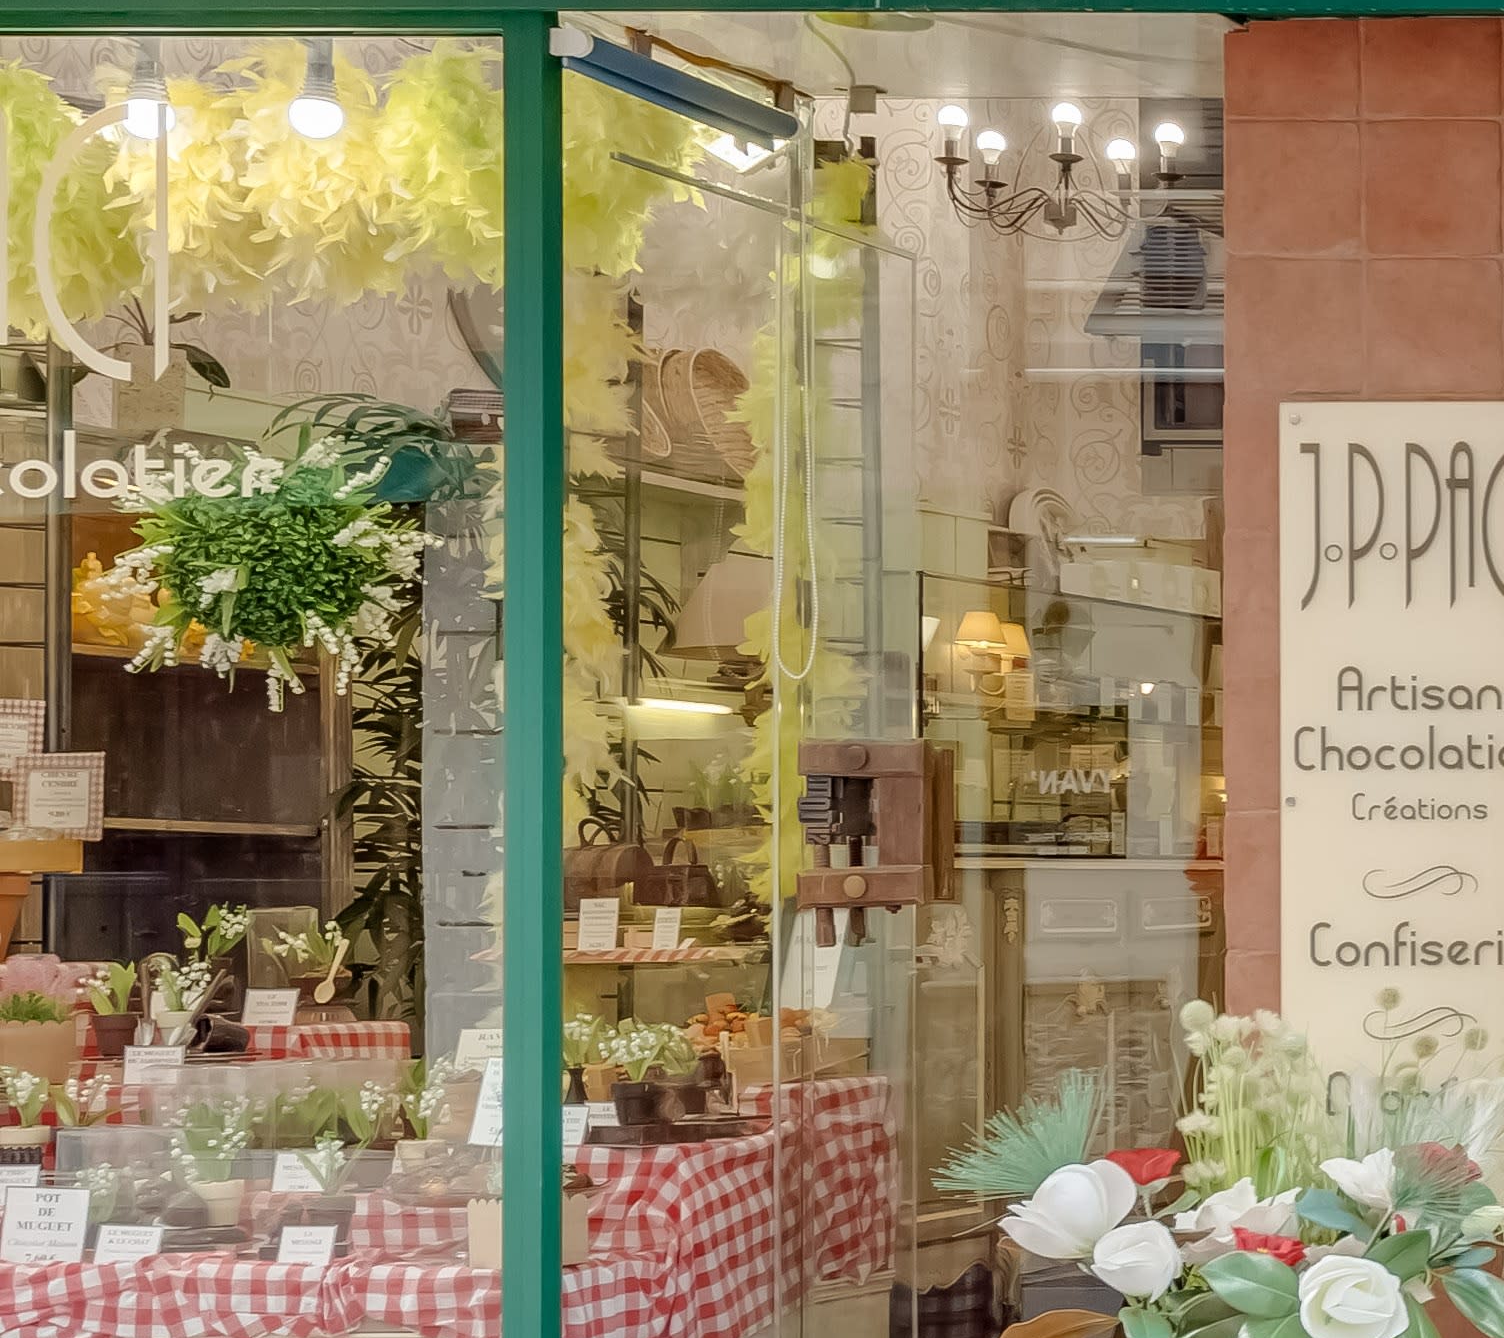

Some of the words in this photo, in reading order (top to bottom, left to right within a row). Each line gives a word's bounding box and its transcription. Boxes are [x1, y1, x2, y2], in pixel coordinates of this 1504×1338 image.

[0, 429, 276, 498] olatier
[1336, 666, 1503, 711] Artisan
[1352, 792, 1488, 821] Créations
